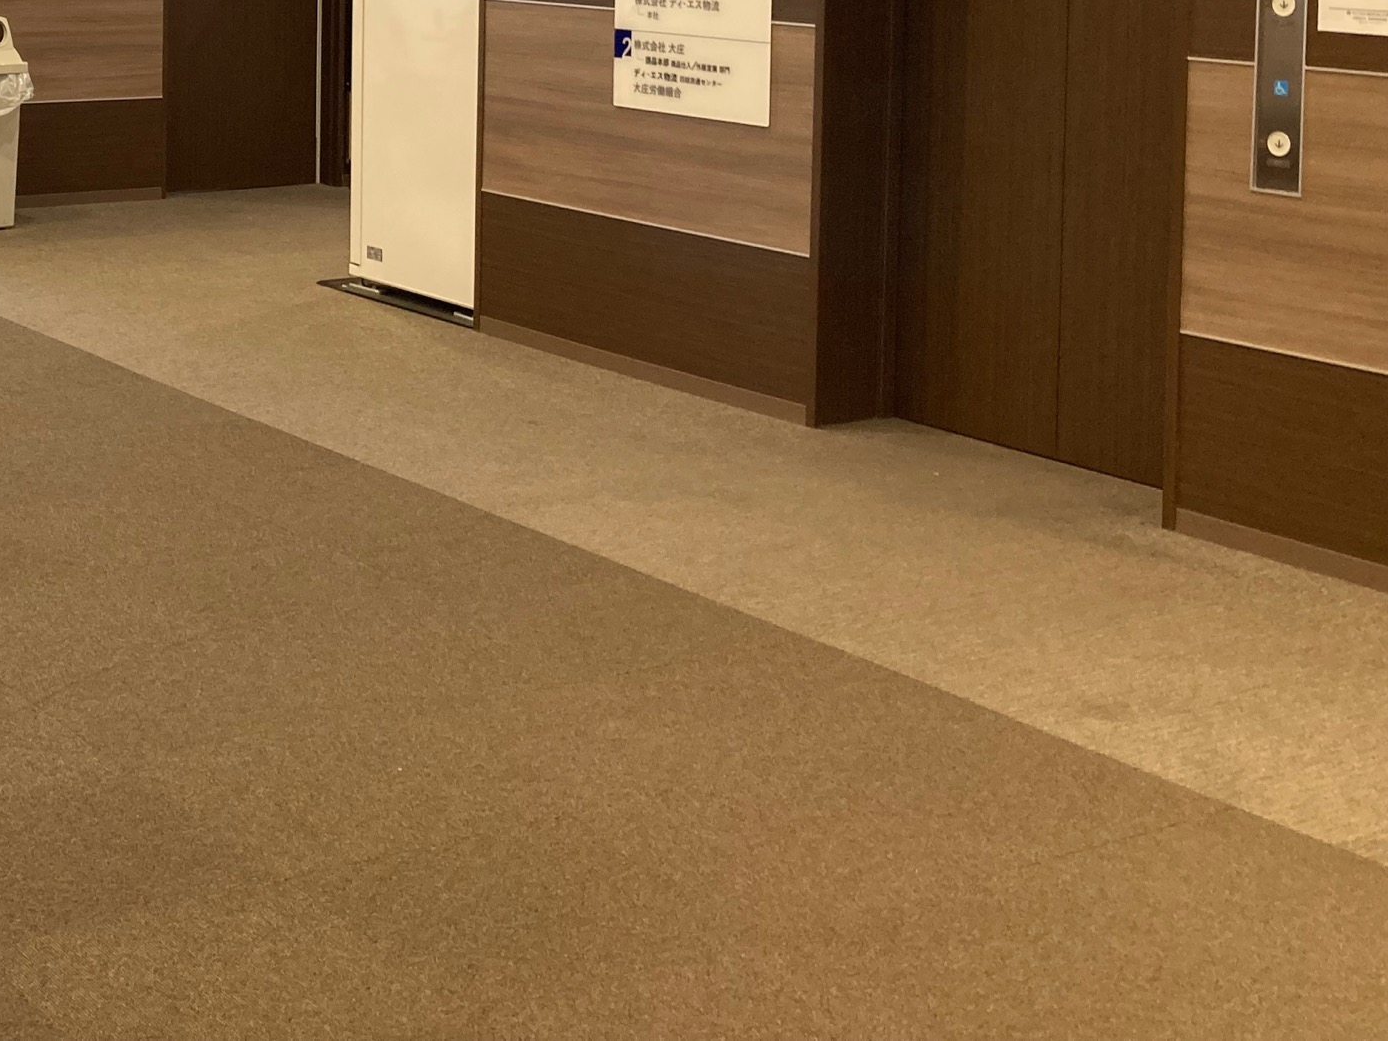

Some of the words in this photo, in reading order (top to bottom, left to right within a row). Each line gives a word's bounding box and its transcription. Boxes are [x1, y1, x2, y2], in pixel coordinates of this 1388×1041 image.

[622, 37, 632, 58] 2
[634, 40, 666, 53] 株式会社
[668, 42, 685, 56] 大庄
